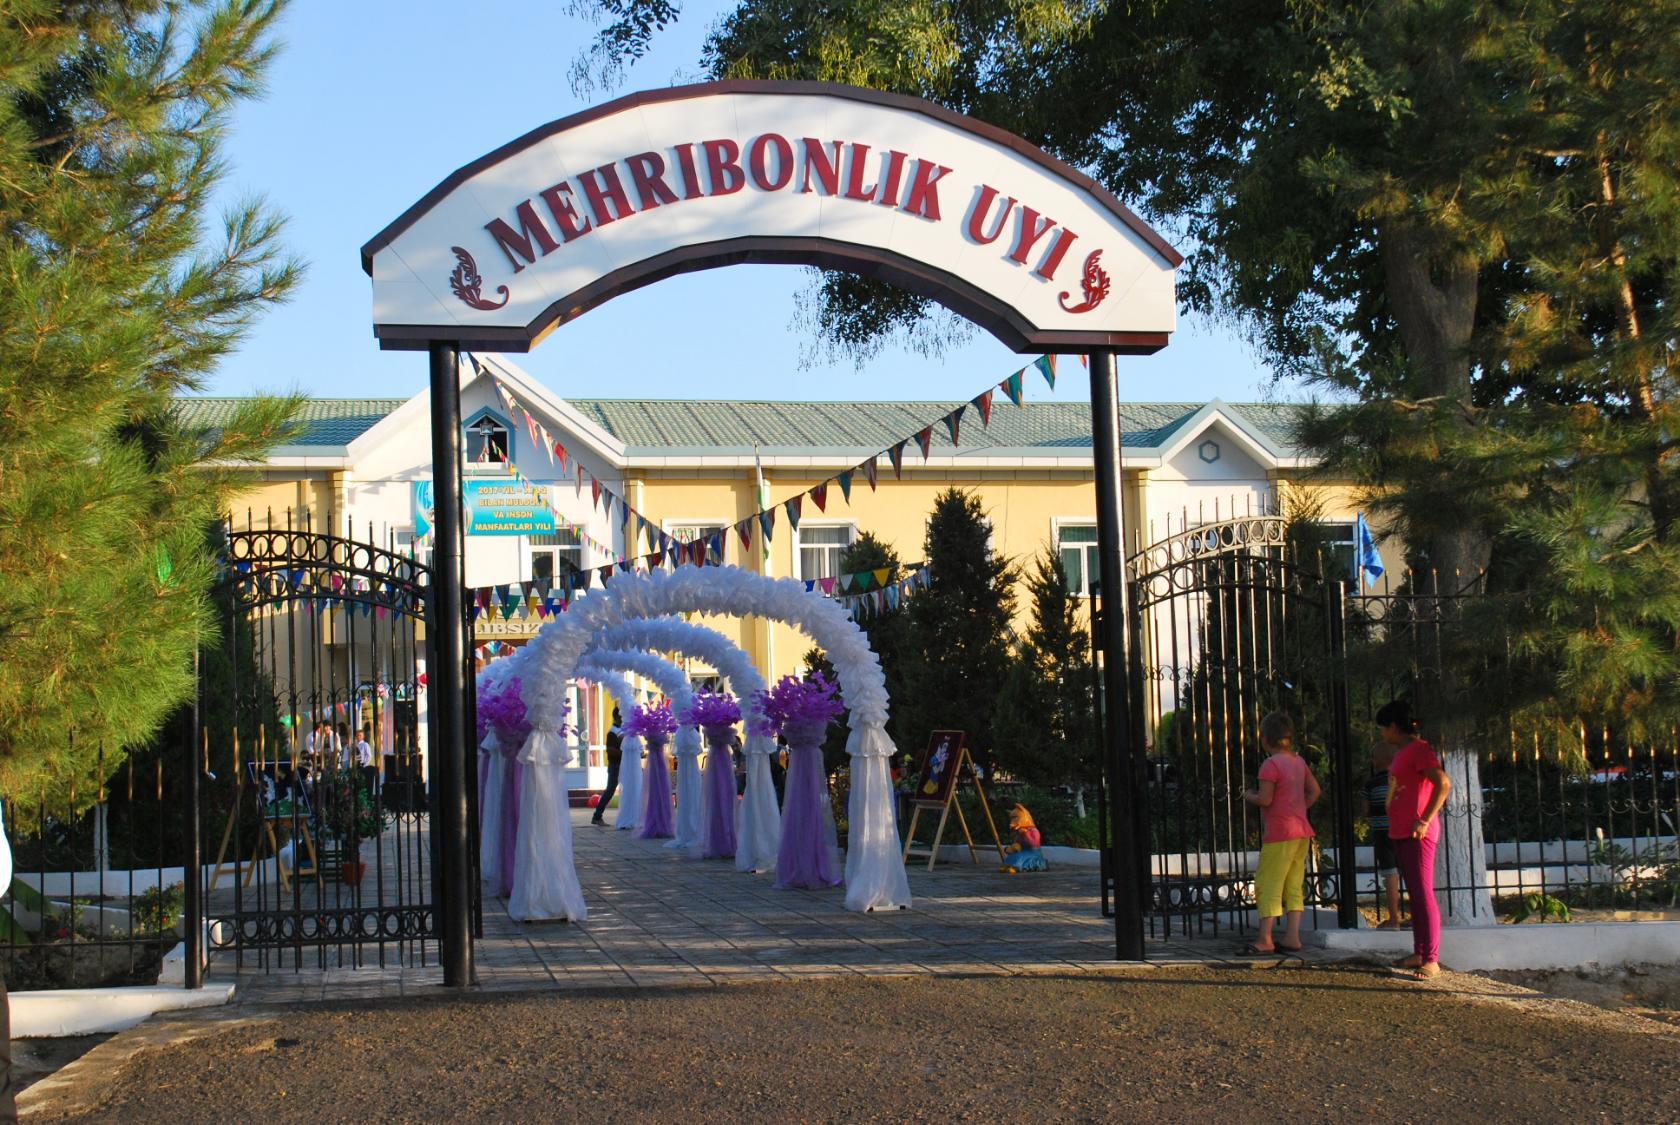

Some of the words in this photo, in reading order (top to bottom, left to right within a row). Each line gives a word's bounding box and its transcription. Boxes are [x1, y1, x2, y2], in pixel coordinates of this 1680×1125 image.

[484, 132, 953, 274] MEHRIBONLIK
[968, 183, 1079, 282] UYI
[475, 523, 533, 531] MANFAATLARI
[535, 523, 551, 531] YILI
